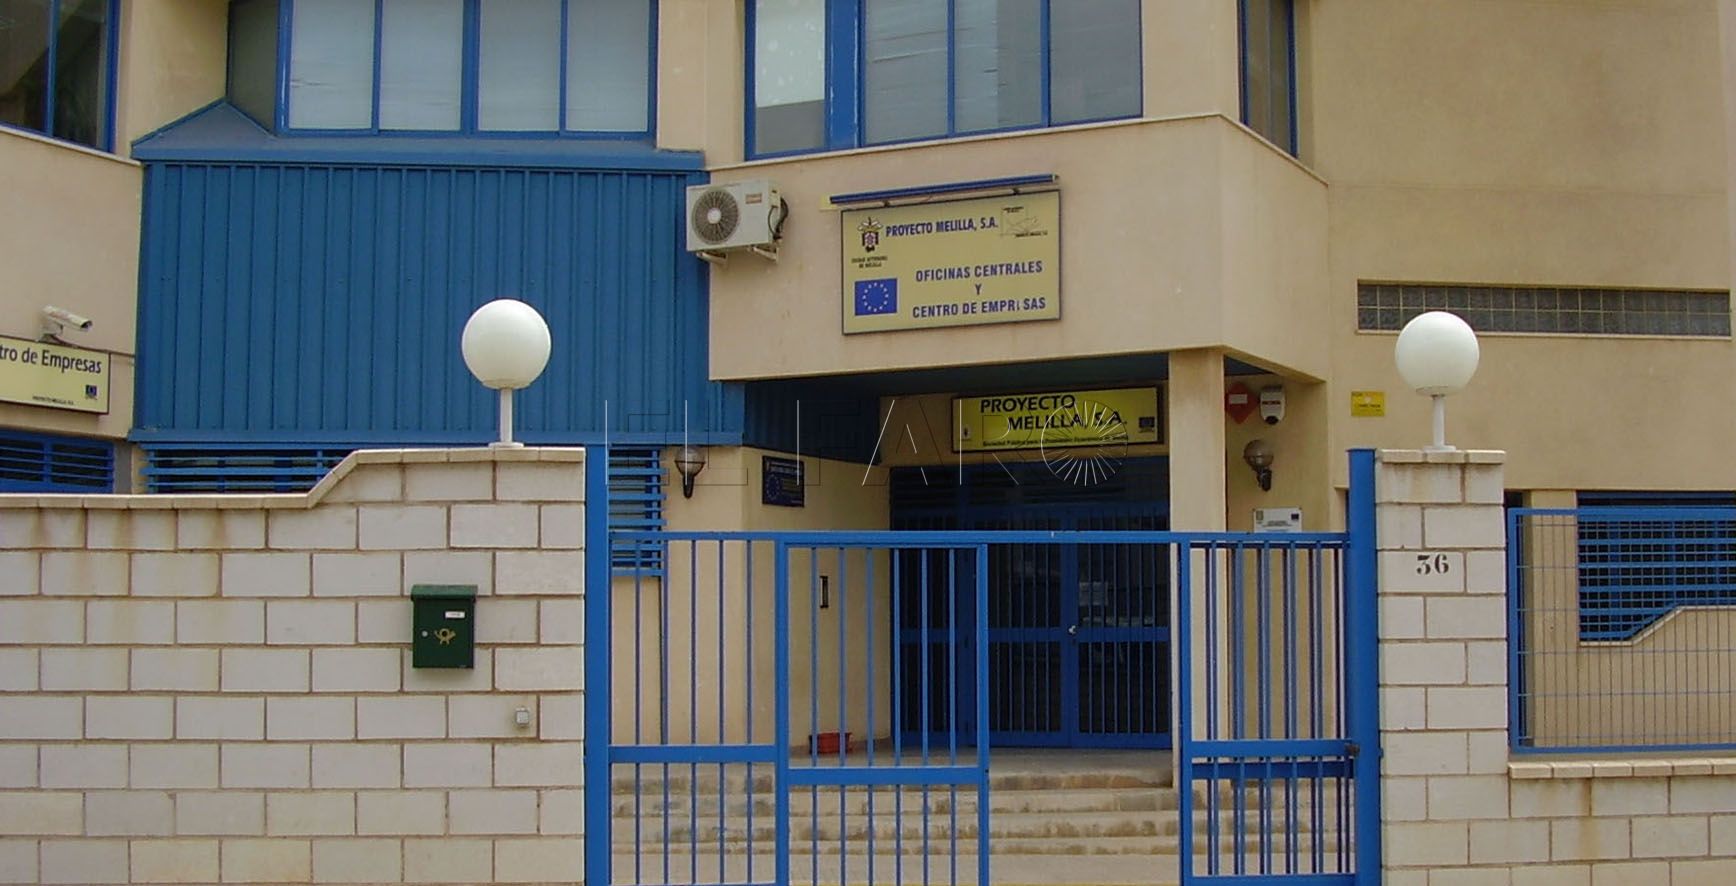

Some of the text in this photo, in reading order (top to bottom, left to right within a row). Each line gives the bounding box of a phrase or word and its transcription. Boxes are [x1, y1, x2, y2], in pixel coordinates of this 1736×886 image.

[886, 216, 998, 237] PROYECTO MELILLA, S.A.
[916, 261, 1042, 282] OFICINAS CENTRALES
[975, 283, 982, 295] Y
[912, 303, 958, 318] CENTRO
[962, 302, 977, 314] DE
[21, 347, 38, 363] de
[41, 349, 102, 373] Empresas
[981, 394, 1075, 413] PROYECTO
[1416, 554, 1449, 575] 36
